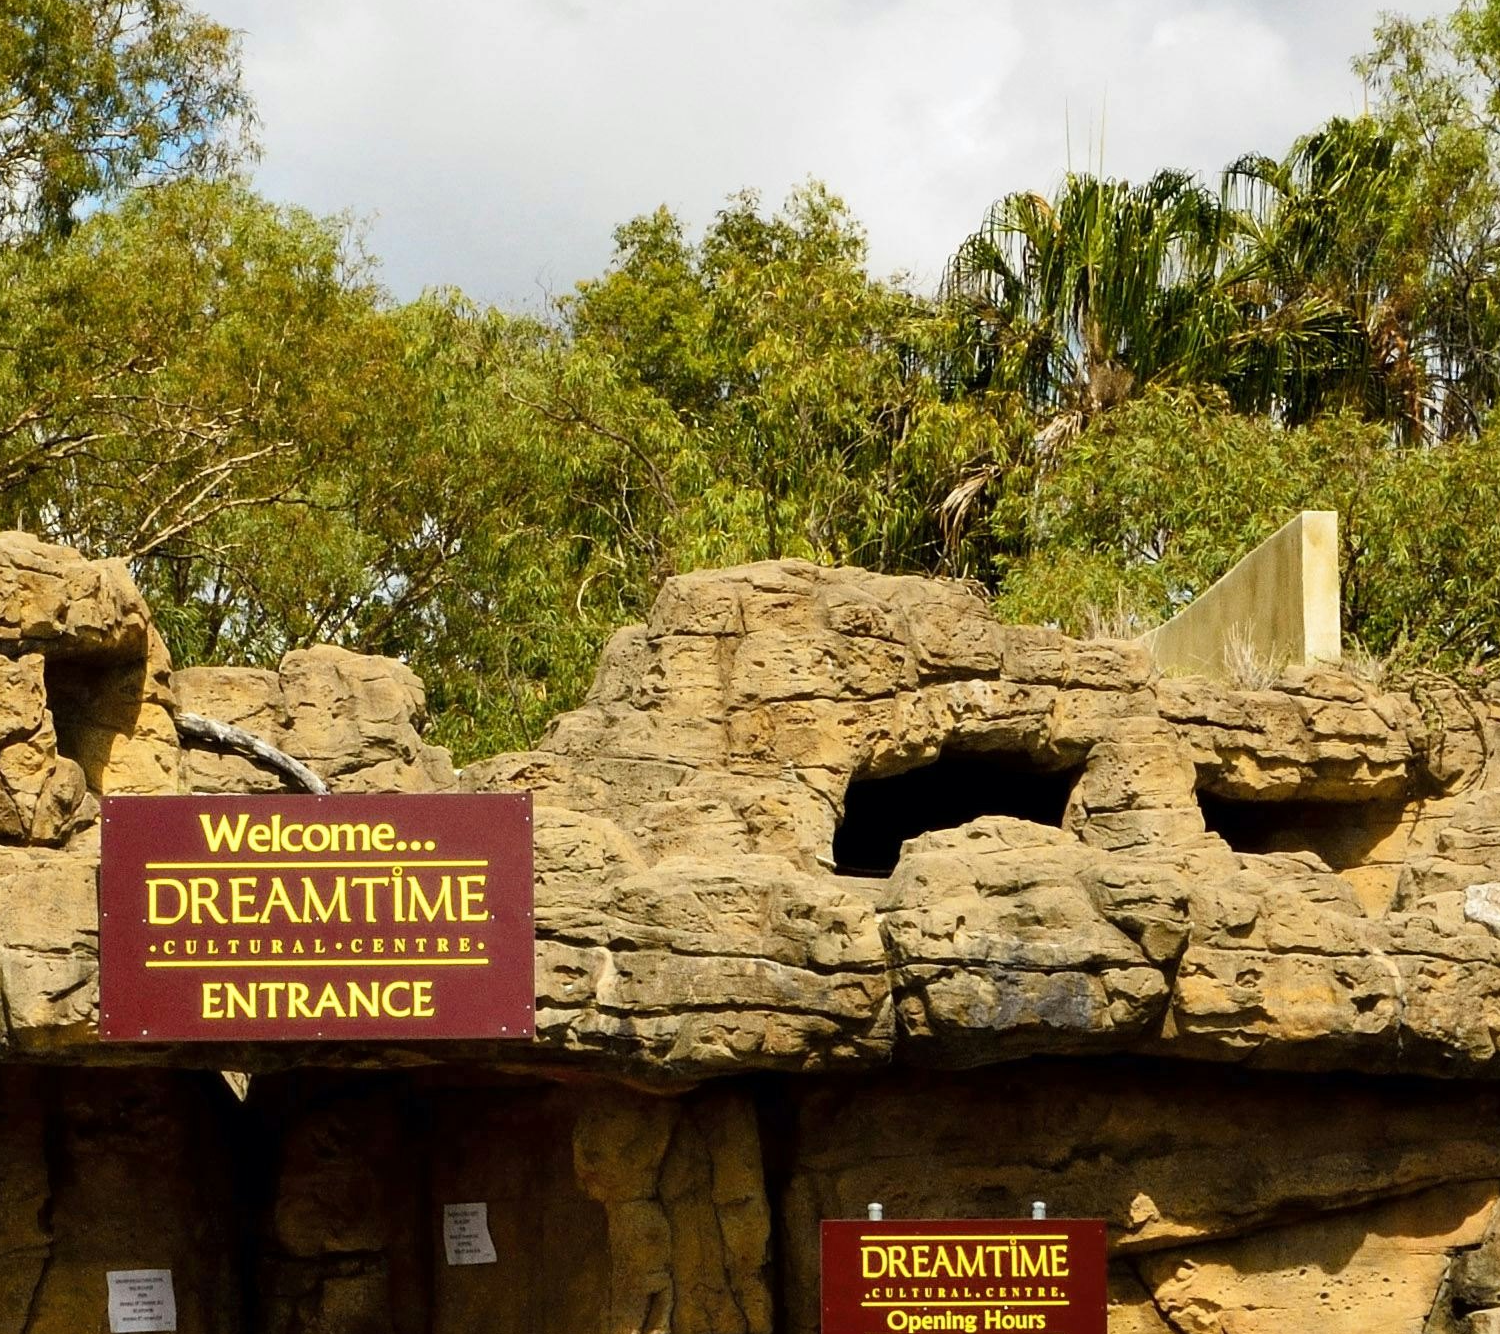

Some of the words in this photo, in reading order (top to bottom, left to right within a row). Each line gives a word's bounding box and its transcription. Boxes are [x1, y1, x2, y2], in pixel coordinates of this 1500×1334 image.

[198, 813, 436, 853] Welcome...
[144, 867, 490, 926] DREAMTIME
[163, 939, 326, 955] CULTURAL
[350, 937, 471, 954] CENTRE
[202, 980, 435, 1019] ENTRANCE
[860, 1240, 1070, 1279] DREAMTIME
[871, 1287, 972, 1299] CULTURAL
[985, 1286, 1059, 1298] CENTRE
[886, 1310, 978, 1334] Opening
[984, 1309, 1046, 1330] Hours
